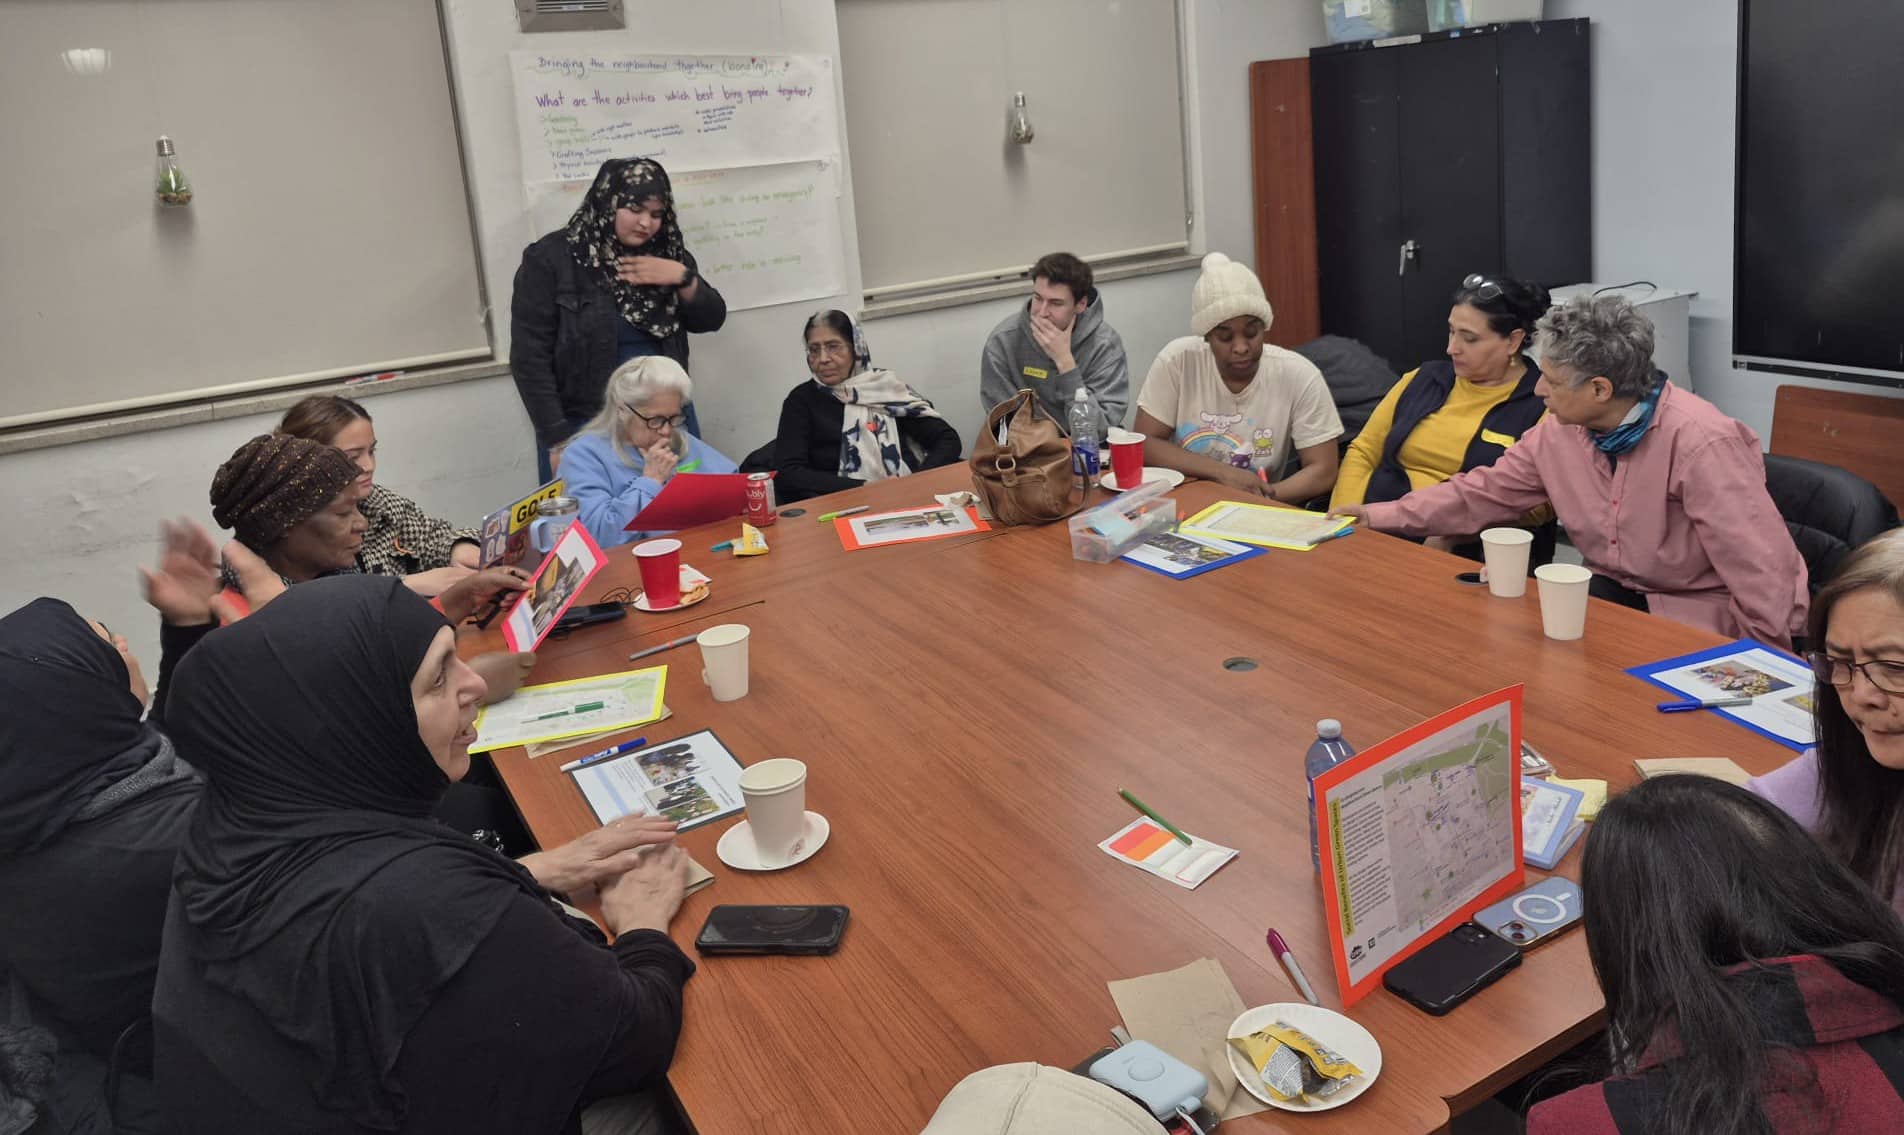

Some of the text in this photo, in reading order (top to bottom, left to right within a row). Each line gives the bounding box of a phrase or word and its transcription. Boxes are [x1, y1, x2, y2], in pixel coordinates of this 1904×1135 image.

[537, 56, 585, 78] Bringing
[590, 57, 605, 68] the
[677, 58, 713, 75] together
[535, 84, 813, 107] What are the activities which best bring people together?
[1336, 851, 1344, 873] Urban
